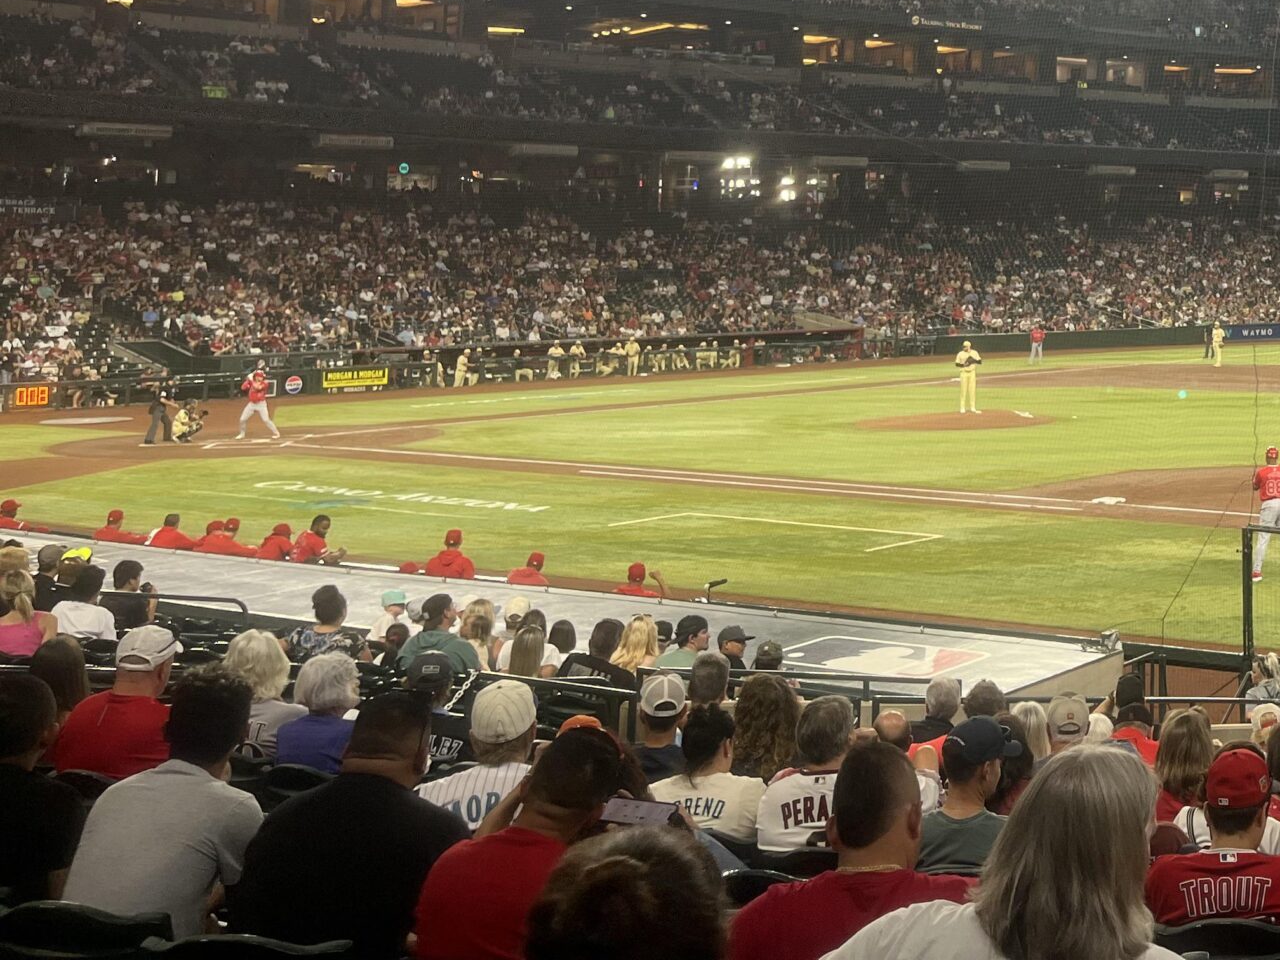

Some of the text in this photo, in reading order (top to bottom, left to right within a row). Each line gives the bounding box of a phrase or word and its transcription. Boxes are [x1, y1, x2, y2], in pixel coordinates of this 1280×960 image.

[1242, 327, 1273, 338] WAYMO
[327, 372, 353, 381] MORGAN
[359, 370, 384, 379] MORGAN
[429, 734, 464, 760] LEZ
[781, 795, 831, 830] PERA
[1179, 876, 1272, 917] TROUT
